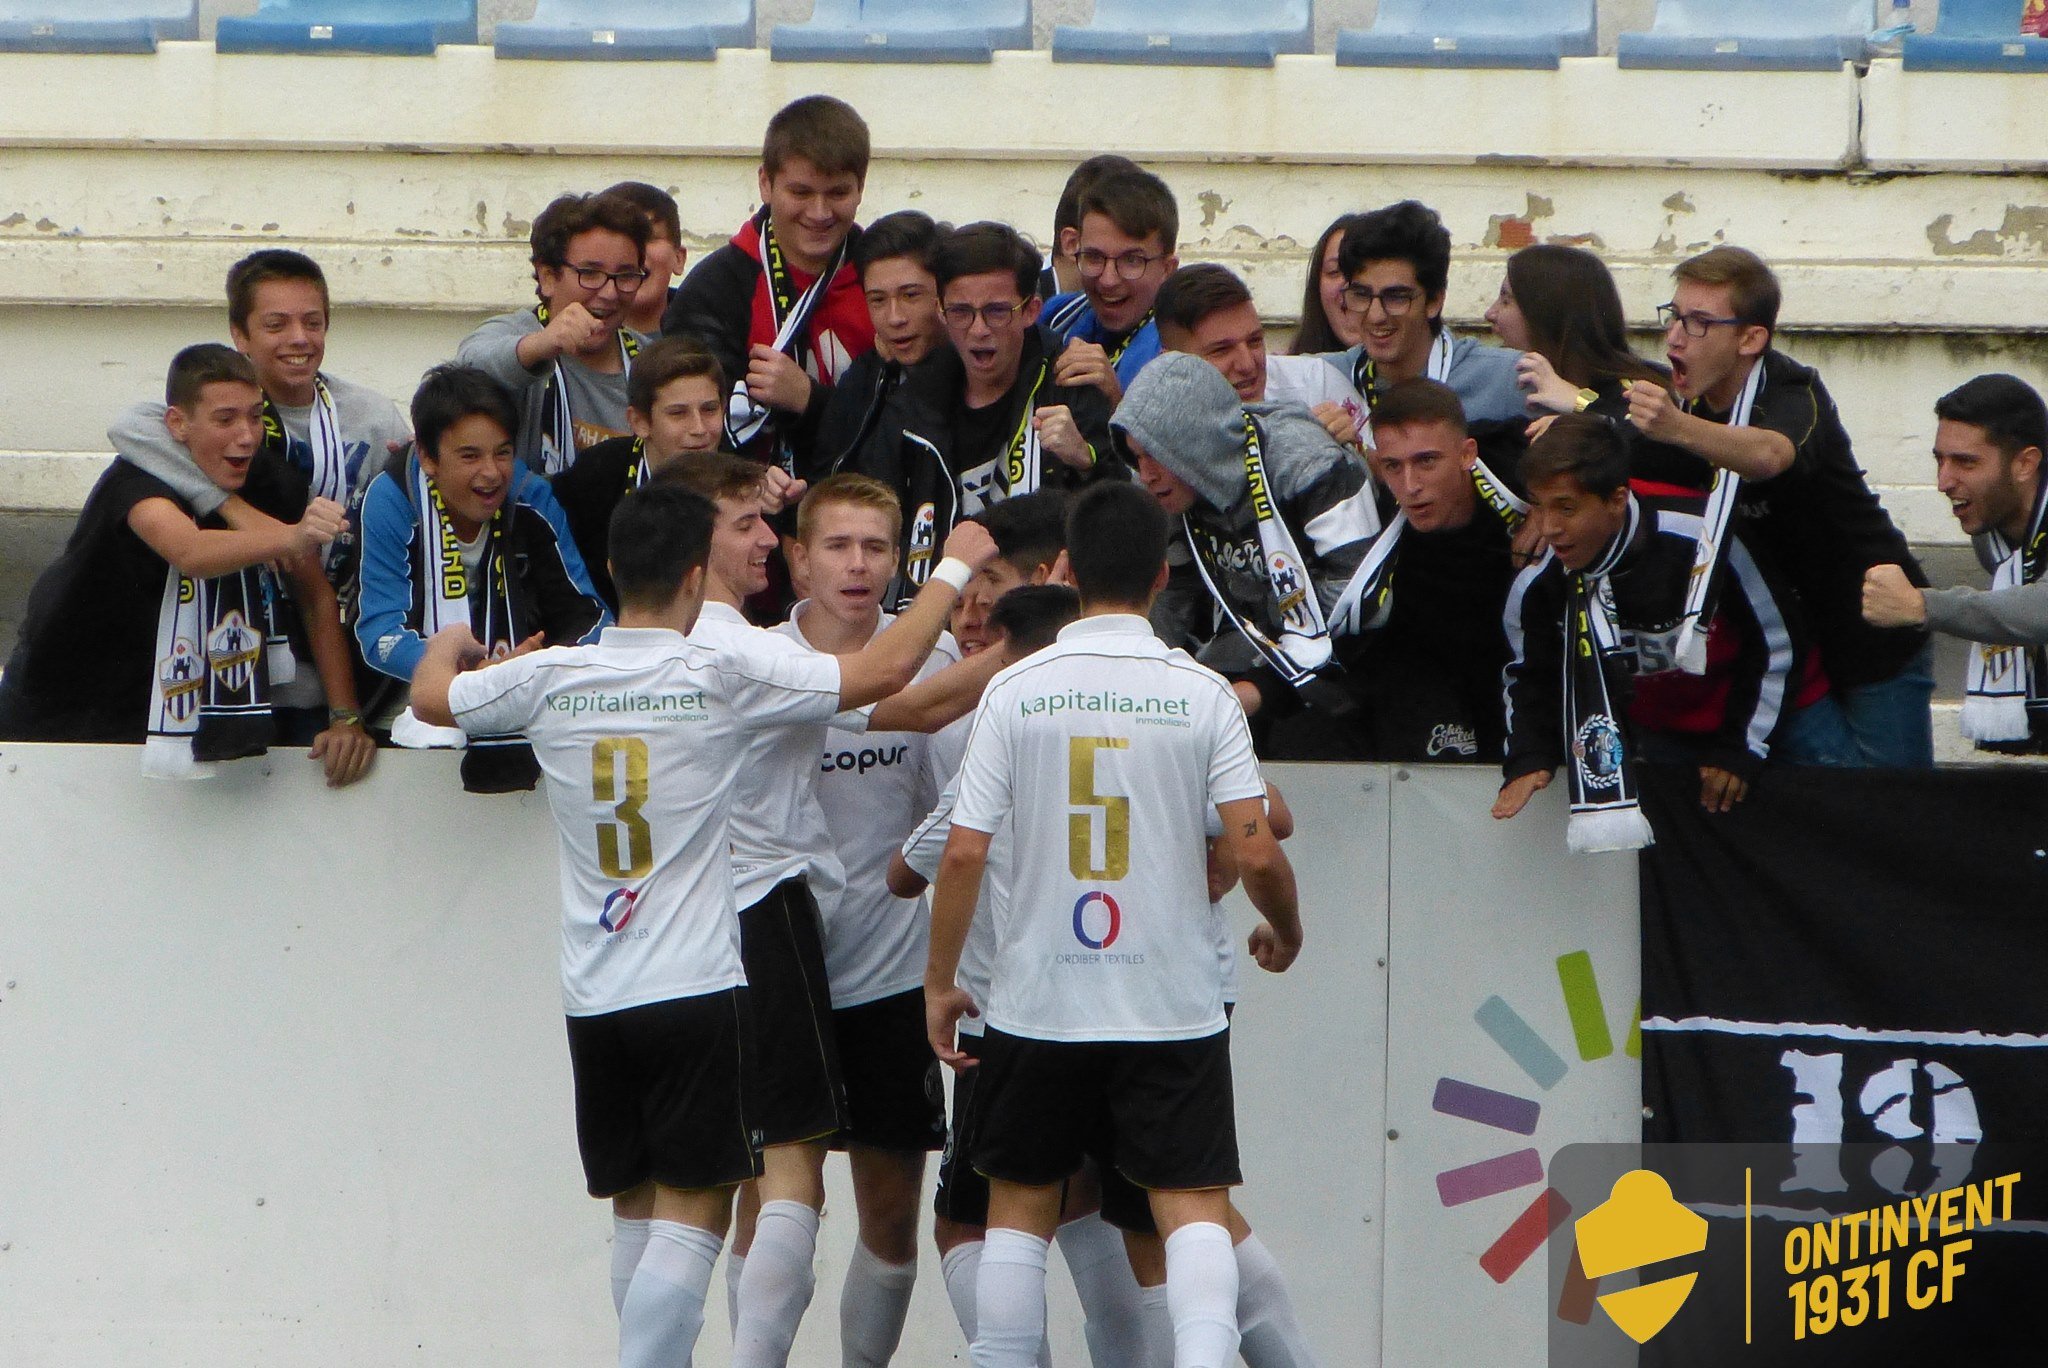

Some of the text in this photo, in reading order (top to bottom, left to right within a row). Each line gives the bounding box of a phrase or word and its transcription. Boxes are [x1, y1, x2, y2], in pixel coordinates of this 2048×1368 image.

[592, 736, 653, 879] 3
[1068, 736, 1130, 881] 5
[1056, 954, 1145, 965] ORDIBER TEXTILES
